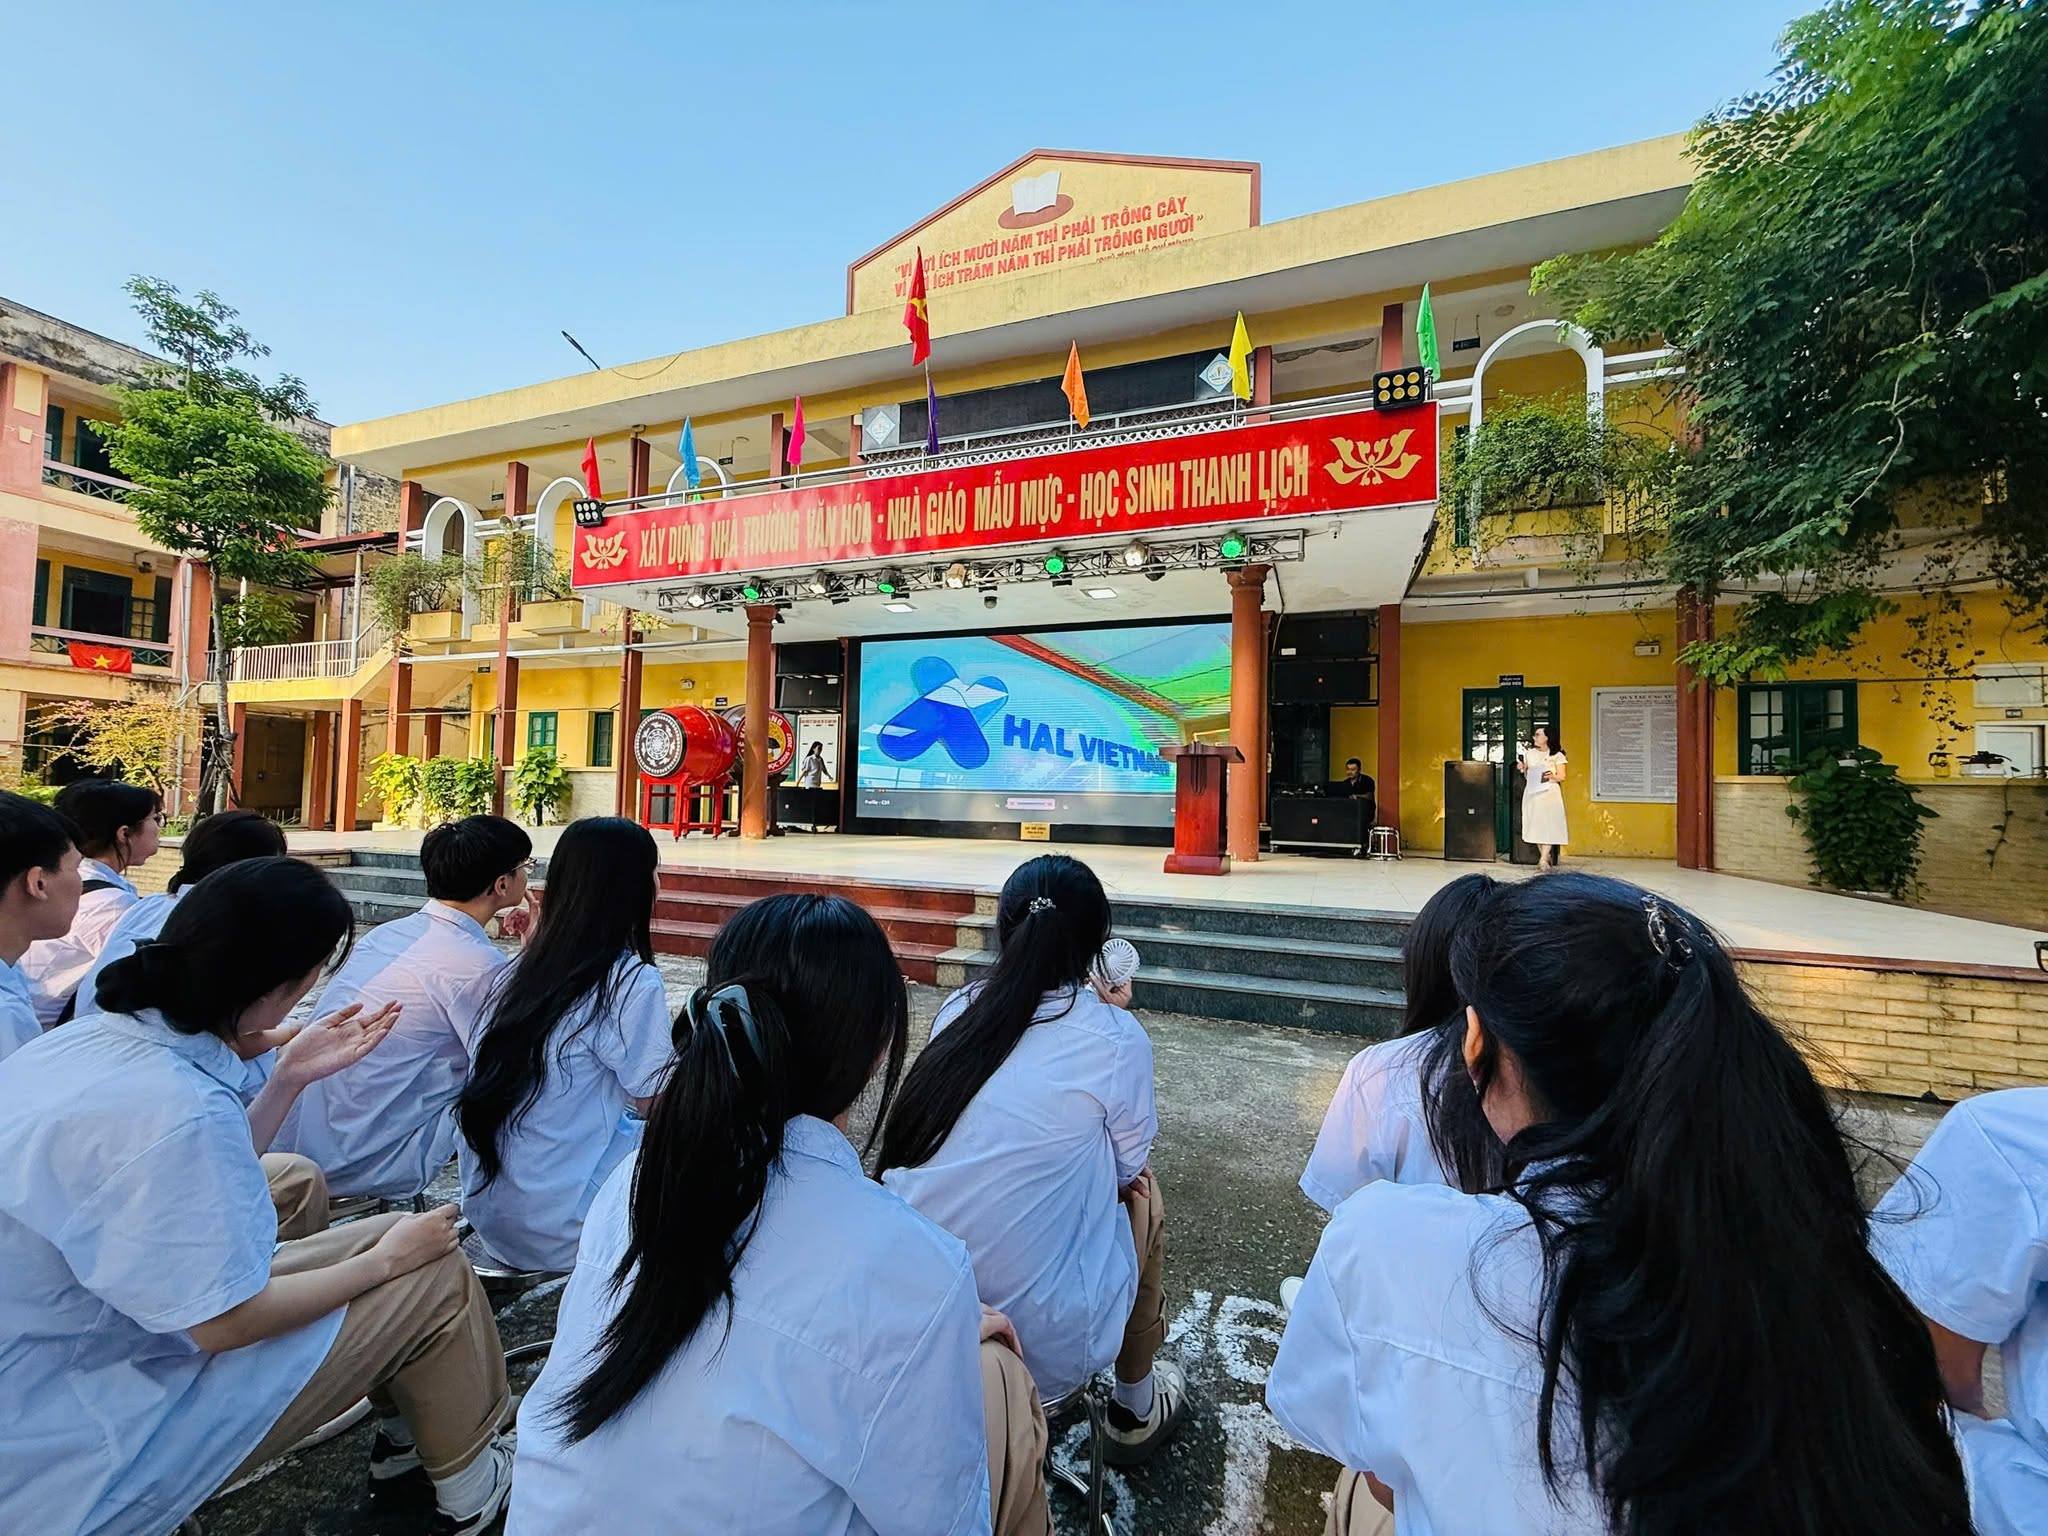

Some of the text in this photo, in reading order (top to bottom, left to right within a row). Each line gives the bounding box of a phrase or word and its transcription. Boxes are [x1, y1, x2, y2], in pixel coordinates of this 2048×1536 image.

[933, 269, 955, 289] ÍCH
[998, 254, 1029, 274] NĂM
[1033, 243, 1054, 266] THÌ
[1058, 237, 1090, 261] PHẢI
[1094, 229, 1142, 253] TRỒNG
[938, 249, 961, 269] ÍCH
[963, 238, 998, 263] MƯỜI
[1001, 233, 1032, 254] NĂM
[1061, 215, 1095, 240] PHẢI
[1101, 206, 1152, 230] TRỒNG
[1157, 196, 1187, 218] CÂY
[639, 521, 665, 568] XÂY
[668, 520, 705, 571] DỰNG
[710, 511, 738, 561] NHÀ
[744, 501, 800, 556] TRƯỜNG
[806, 498, 838, 550] VĂN
[841, 493, 872, 545] HÓA
[886, 486, 921, 541] NHÀ
[926, 482, 966, 537] GIÁO
[974, 470, 1015, 531] MẪU
[1020, 473, 1063, 533] MỰC
[1080, 469, 1119, 527] HỌC
[1125, 462, 1175, 515] SINH
[1180, 452, 1251, 509] THANH
[1258, 445, 1309, 509] LỊCH
[1003, 713, 1074, 758] HAL
